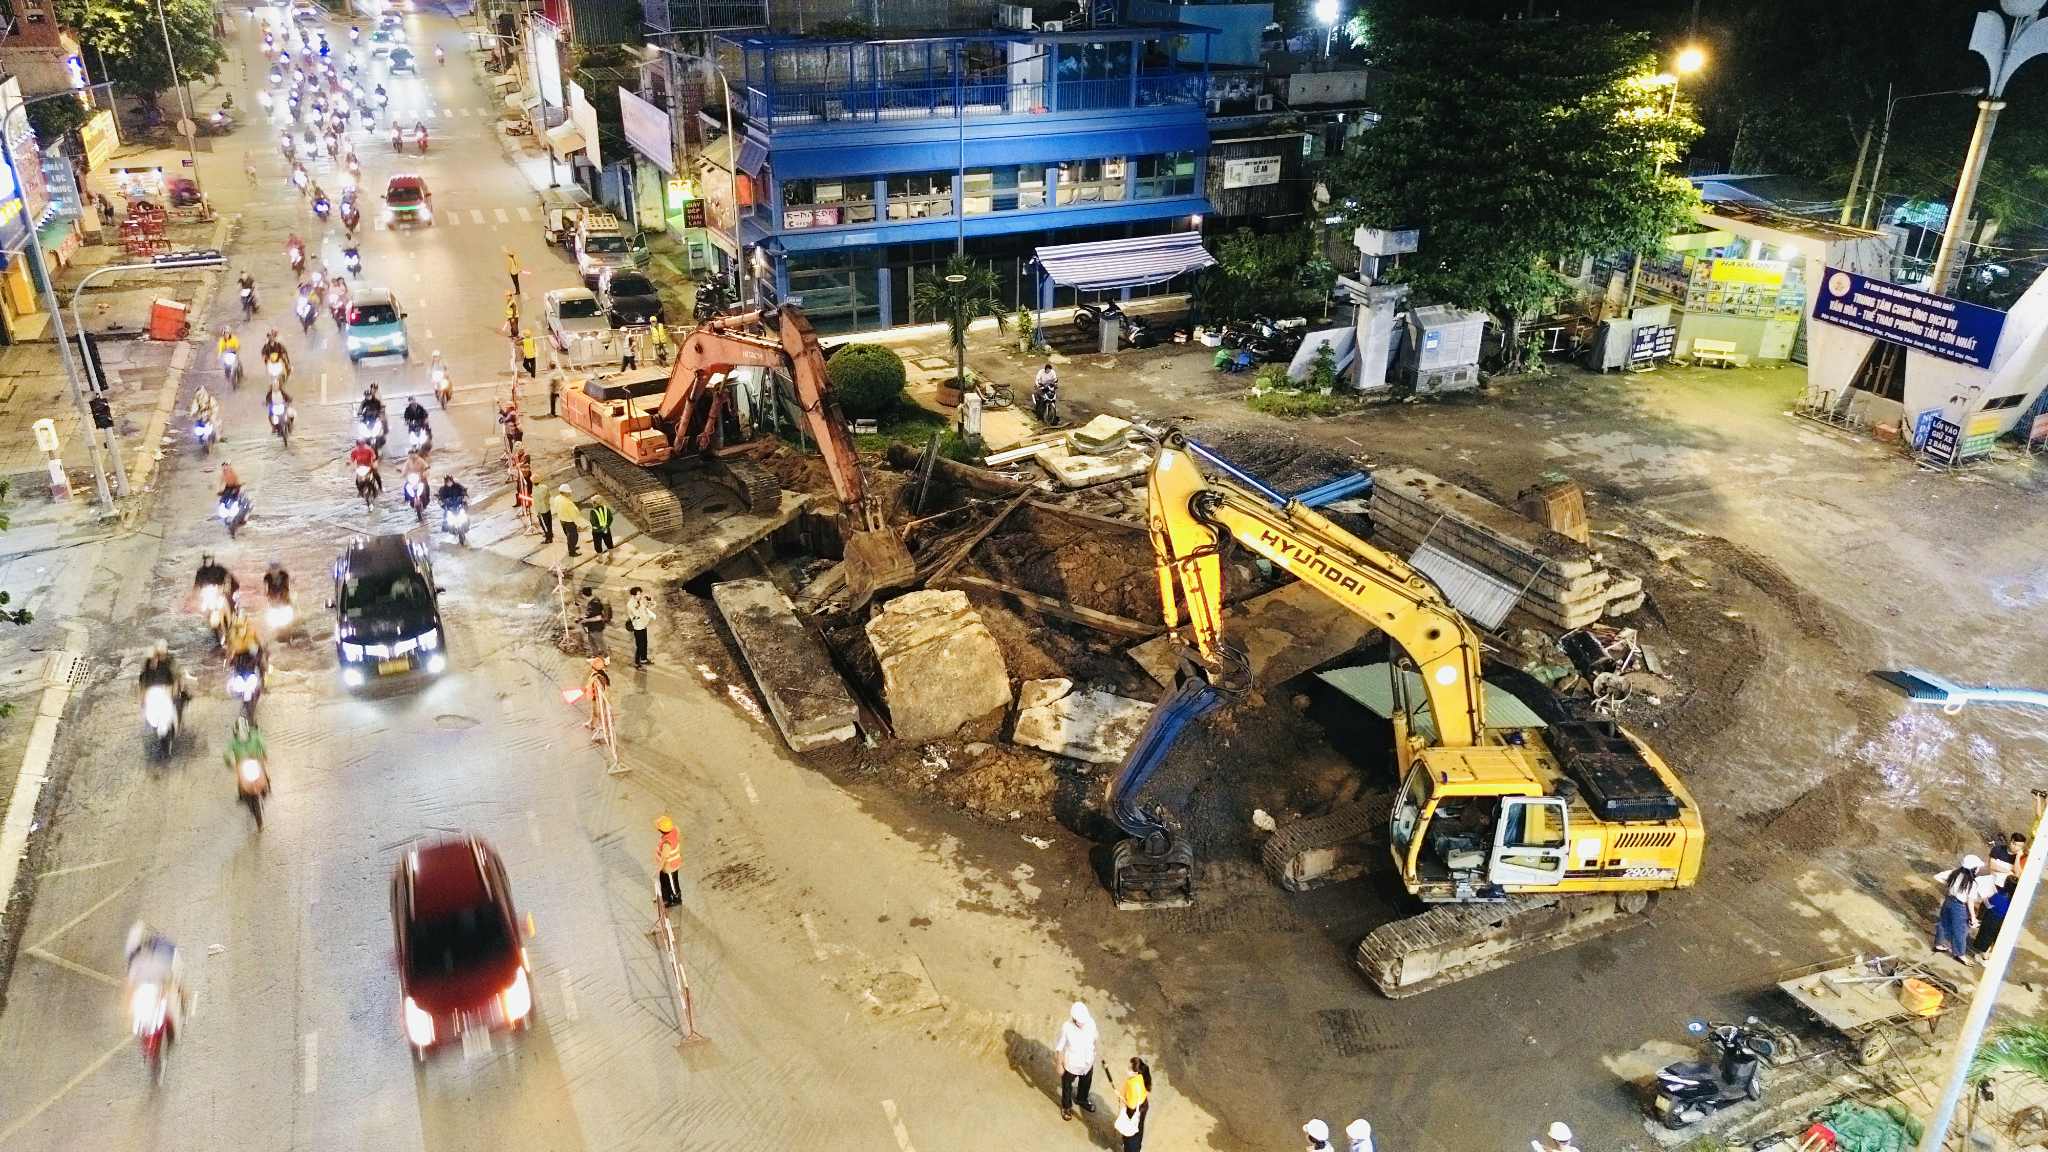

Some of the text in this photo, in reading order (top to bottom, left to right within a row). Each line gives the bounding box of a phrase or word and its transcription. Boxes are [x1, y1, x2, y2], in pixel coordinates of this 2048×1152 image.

[1853, 292, 1876, 308] TRUNG
[1876, 298, 1892, 312] TÂM
[1892, 303, 1912, 318] CUNG
[1876, 313, 1894, 328] THAO
[1894, 318, 1924, 336] PHƯỜNG
[1939, 331, 1956, 345] SƠN
[1955, 335, 1978, 351] NHẤT
[1944, 425, 1958, 436] VÀO
[1944, 434, 1954, 445] XE
[1927, 438, 1933, 446] 2
[1261, 530, 1366, 595] HYUNDAI
